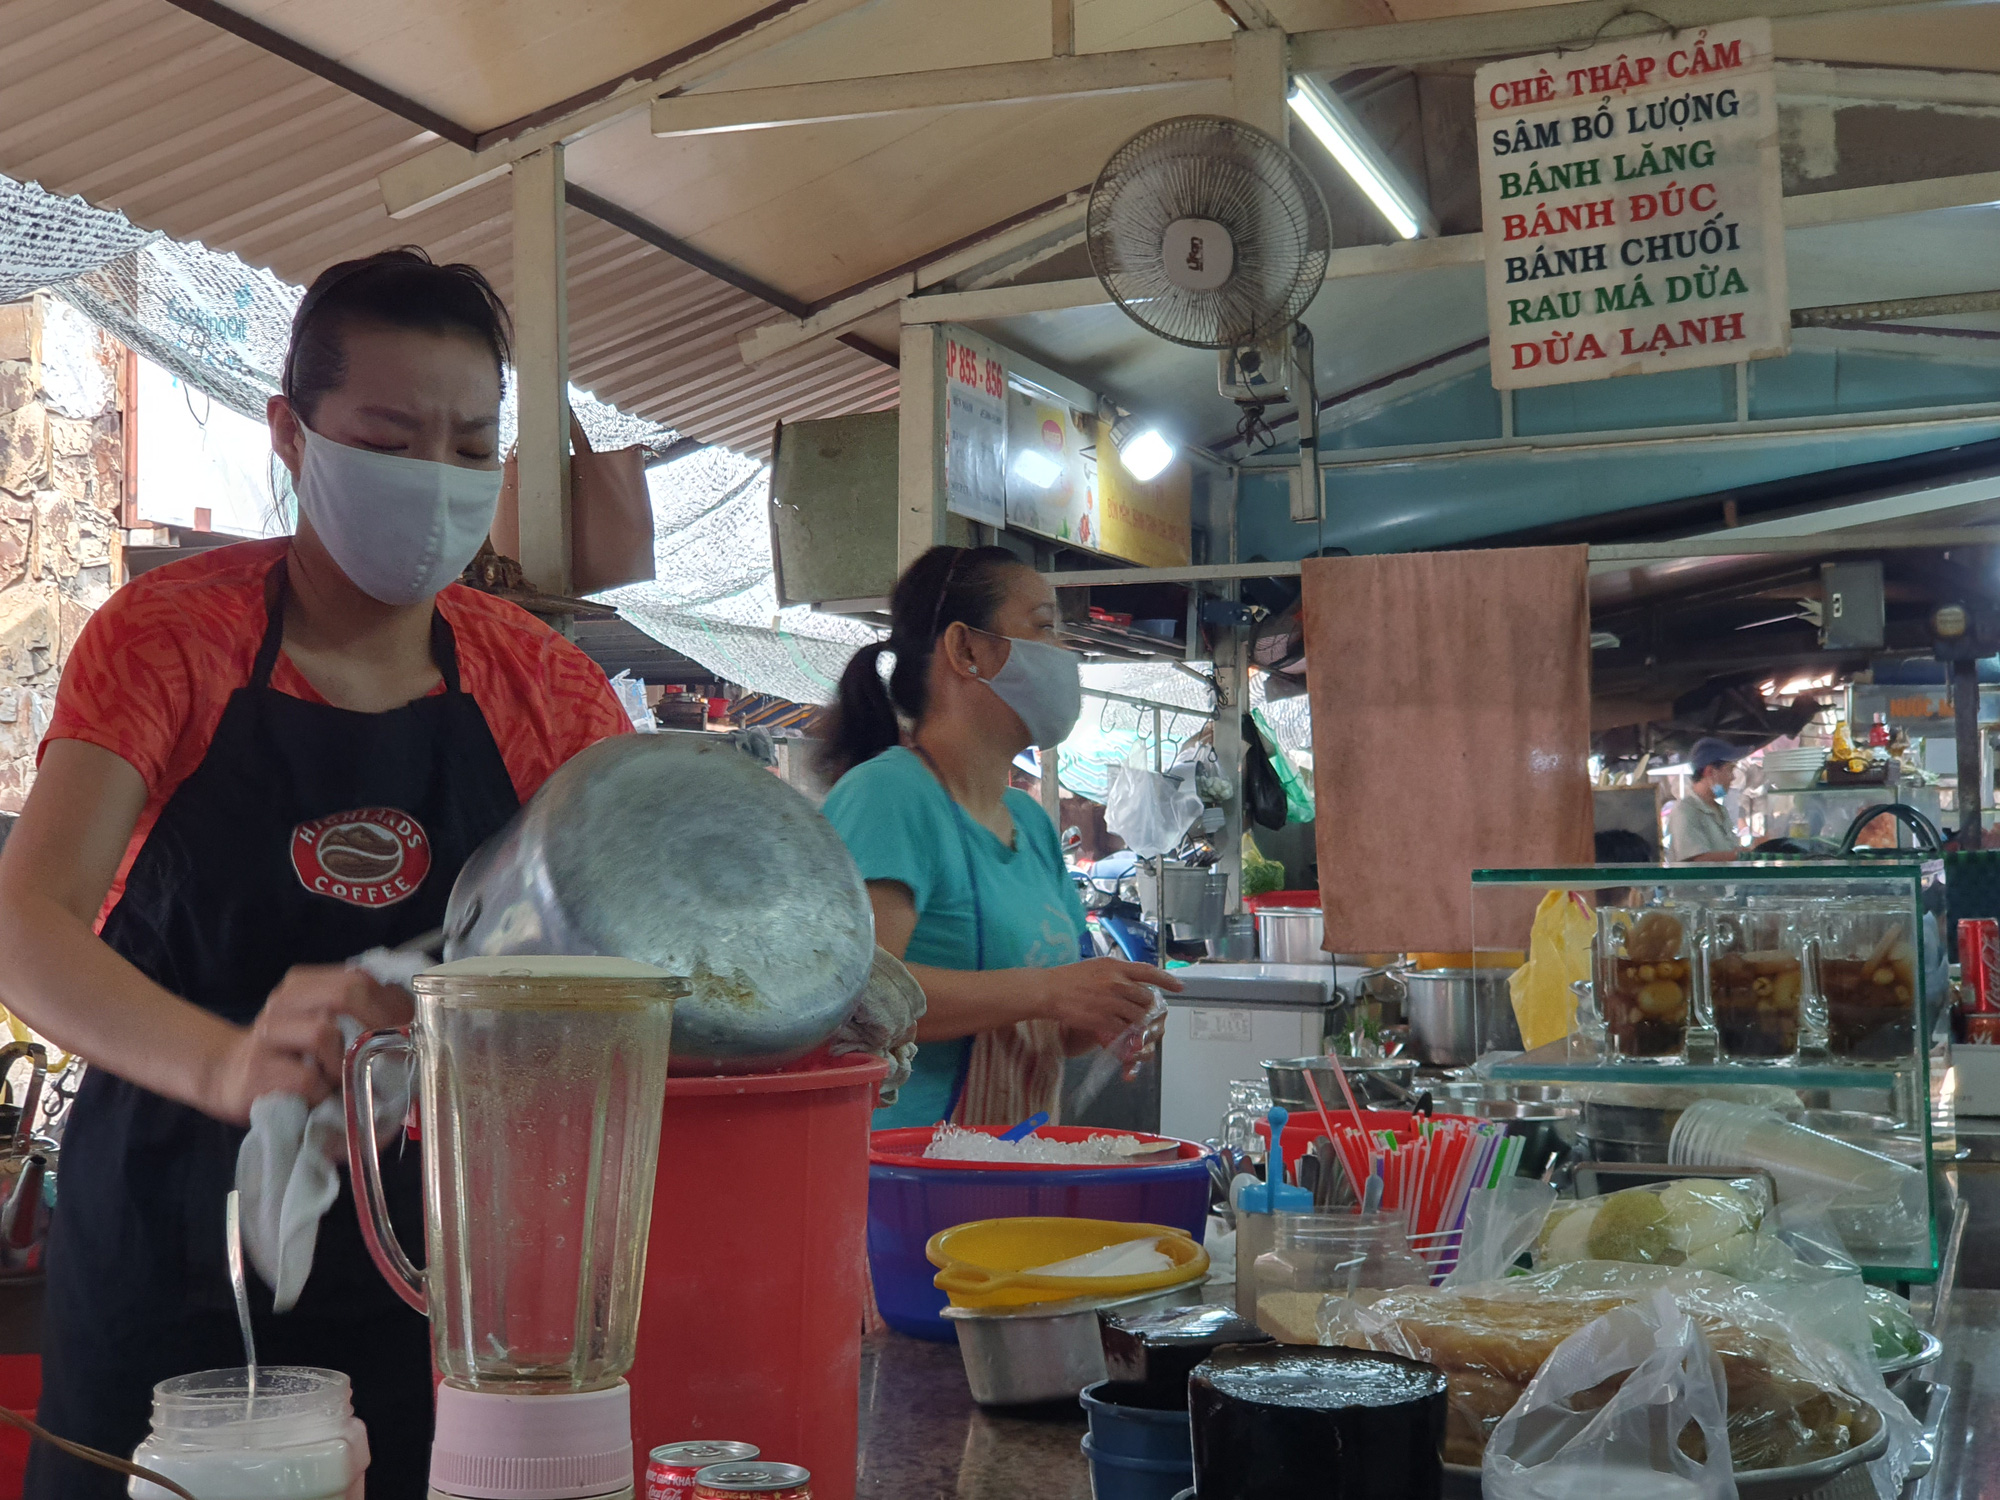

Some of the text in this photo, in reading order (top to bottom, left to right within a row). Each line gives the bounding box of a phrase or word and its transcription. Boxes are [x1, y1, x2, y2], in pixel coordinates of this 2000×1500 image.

[1489, 29, 1742, 110] CHÈ THẬP CẨM
[1492, 88, 1740, 156] SÂM BỔ LƯỢNG
[1499, 139, 1716, 200] BÁNH LĂNG
[1502, 181, 1718, 242] BÁNH ĐÚC
[1505, 212, 1741, 284] BÁNH CHUỐI
[1507, 263, 1749, 327] RAU MÁ DỪA
[1511, 312, 1747, 370] DỪA LẠNH
[959, 344, 977, 388] 855
[985, 358, 1003, 400] 856
[314, 876, 411, 903] COFFEE
